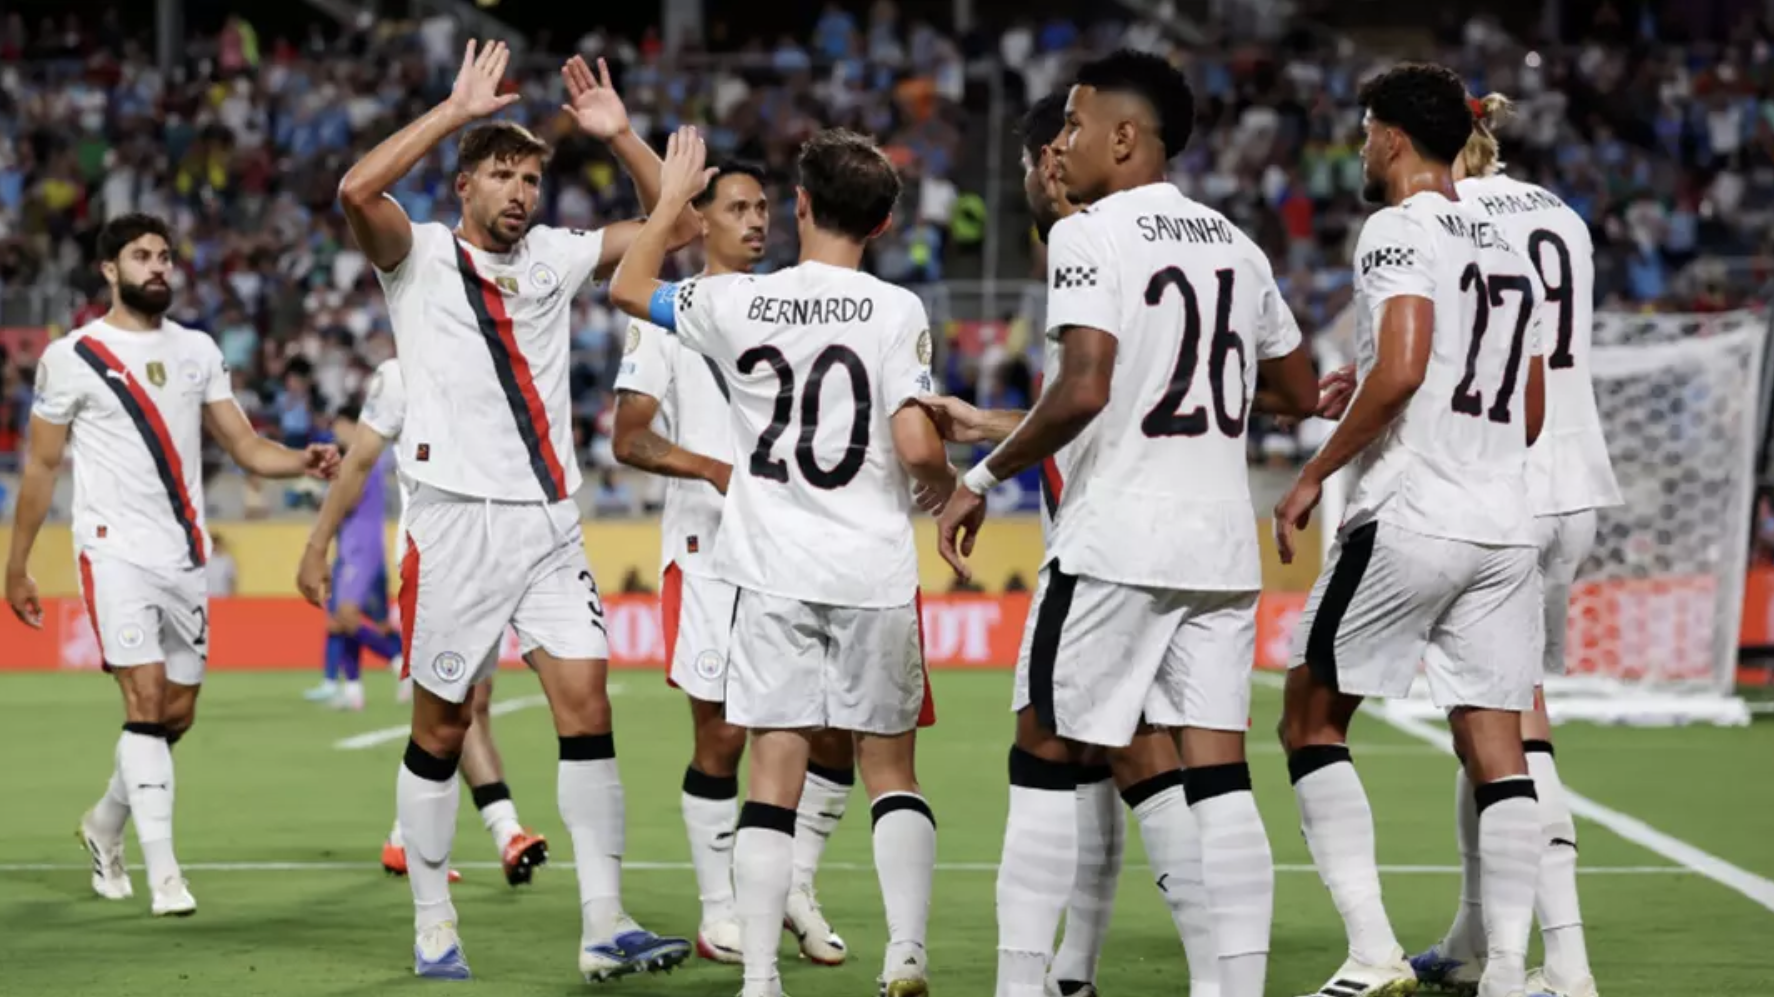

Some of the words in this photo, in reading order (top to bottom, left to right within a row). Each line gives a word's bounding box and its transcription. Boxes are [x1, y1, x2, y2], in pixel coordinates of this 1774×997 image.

[1137, 213, 1233, 244] SAVINHO
[1528, 228, 1573, 370] 9
[748, 296, 873, 325] BERNARDO
[1141, 265, 1248, 438] 26
[1451, 262, 1533, 424] 27
[736, 344, 871, 490] 20
[191, 604, 208, 645] 2
